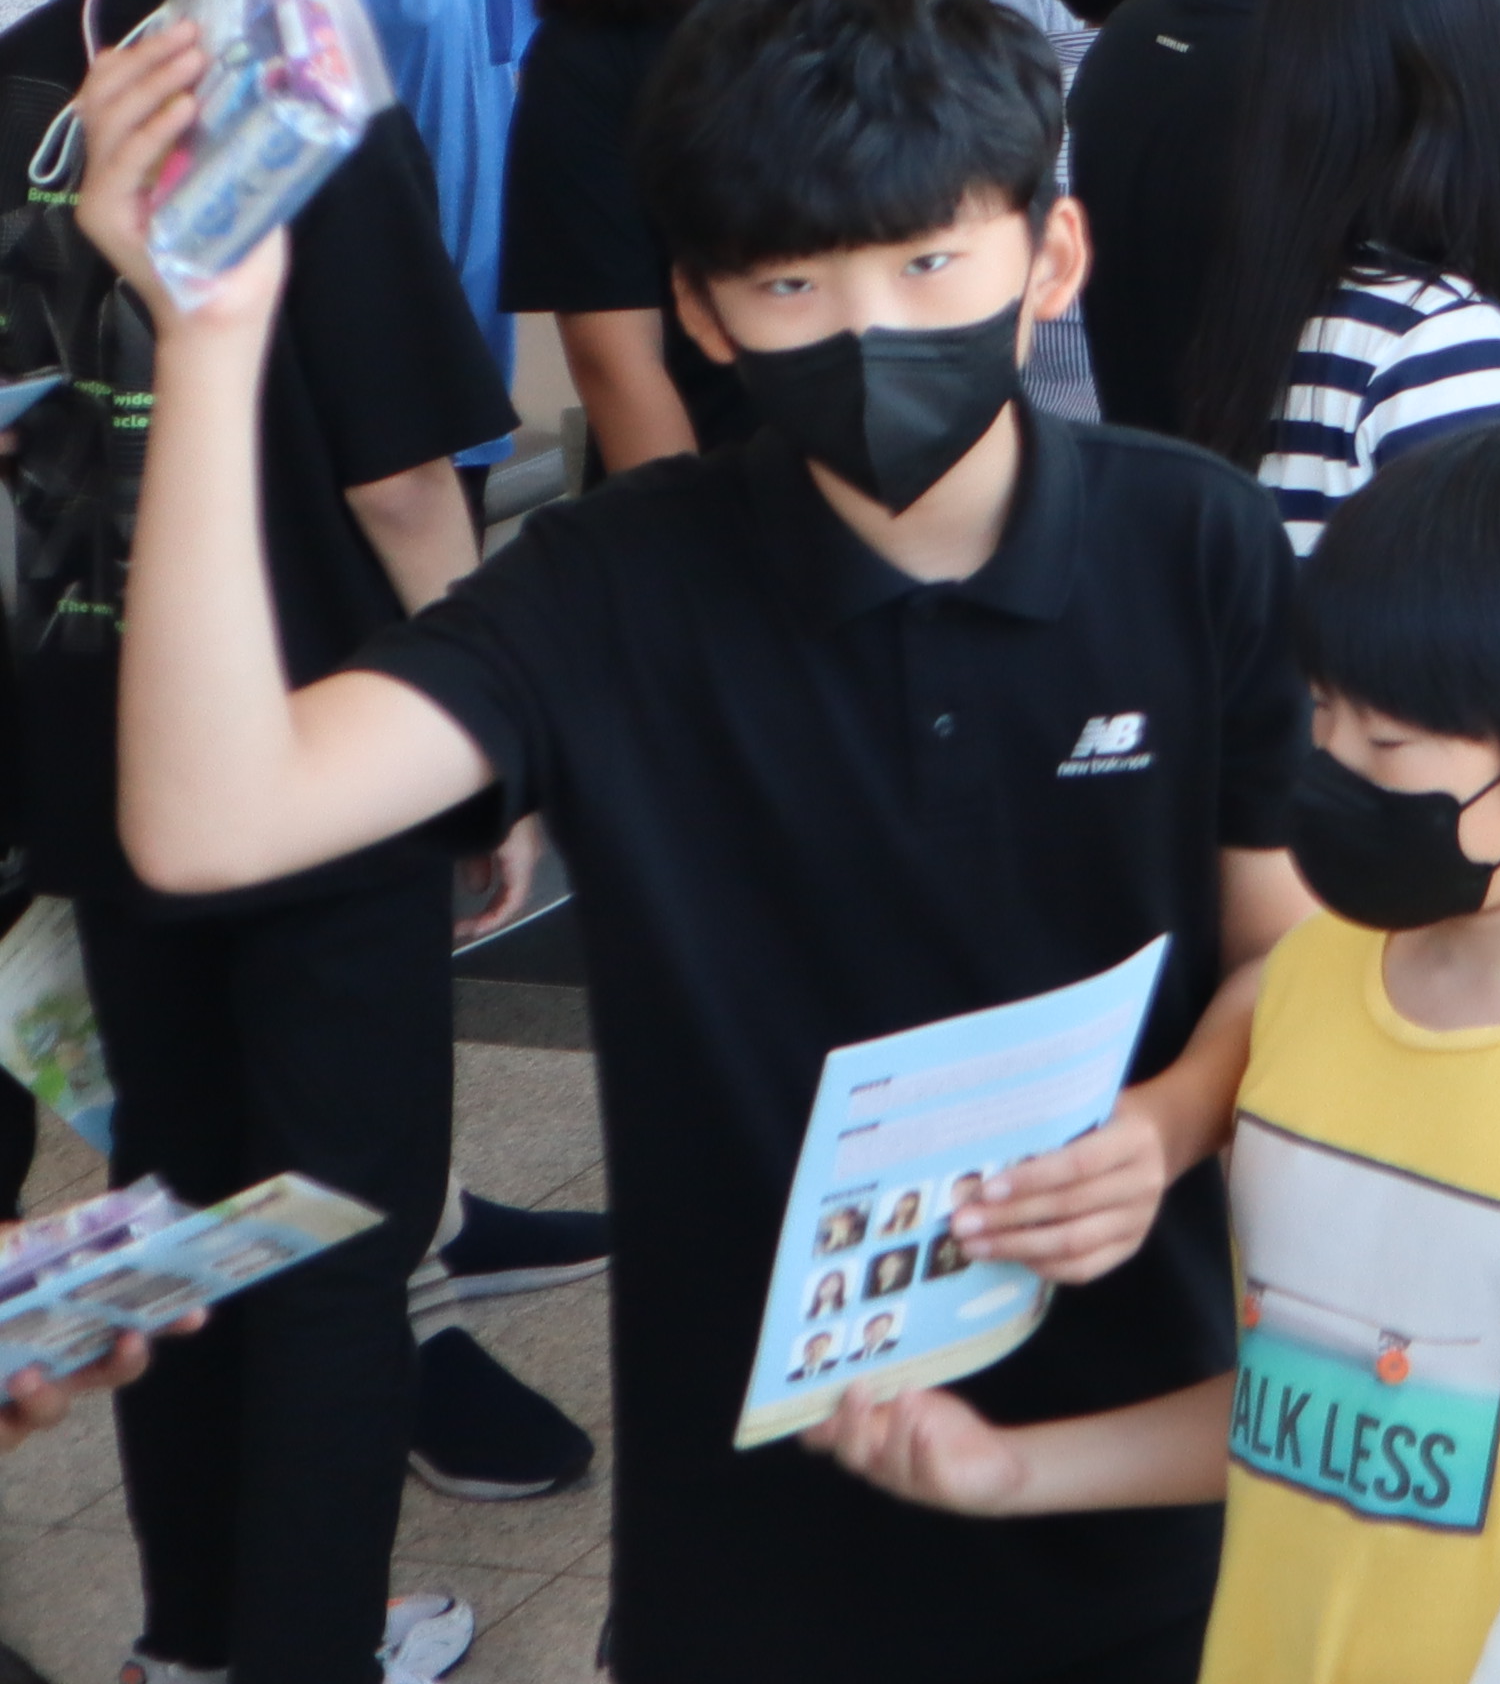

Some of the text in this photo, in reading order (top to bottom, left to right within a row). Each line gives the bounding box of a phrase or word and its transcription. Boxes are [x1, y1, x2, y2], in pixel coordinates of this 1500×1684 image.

[27, 187, 67, 204] Break
[1231, 1365, 1457, 1512] ALK LESS
